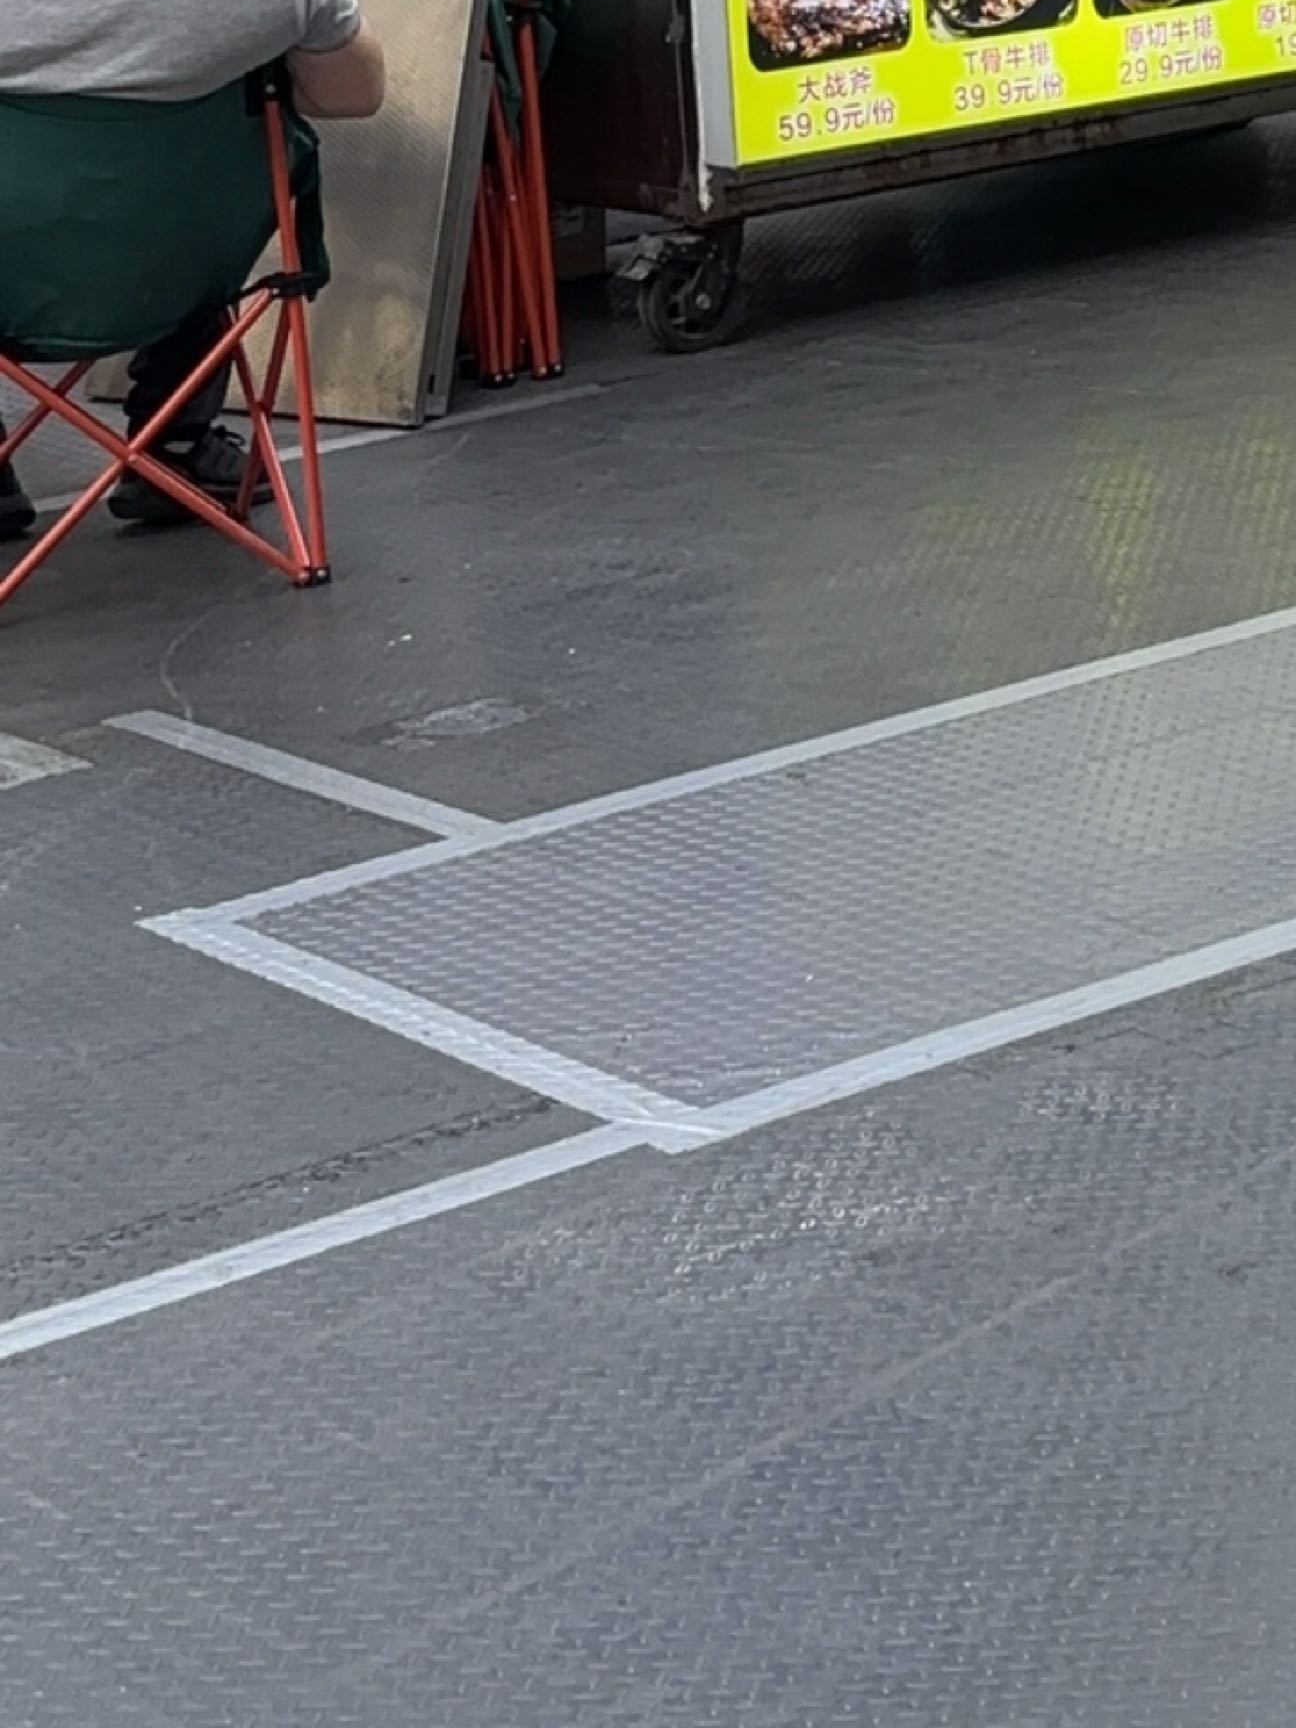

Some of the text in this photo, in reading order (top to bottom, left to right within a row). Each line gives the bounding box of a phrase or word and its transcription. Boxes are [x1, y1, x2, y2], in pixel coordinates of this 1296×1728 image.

[1124, 12, 1214, 53] 原切牛排
[962, 40, 1051, 76] T骨牛排
[1119, 45, 1223, 86] 29.9元/份
[797, 66, 873, 104] 大战斧
[777, 98, 896, 142] 59.9元/份
